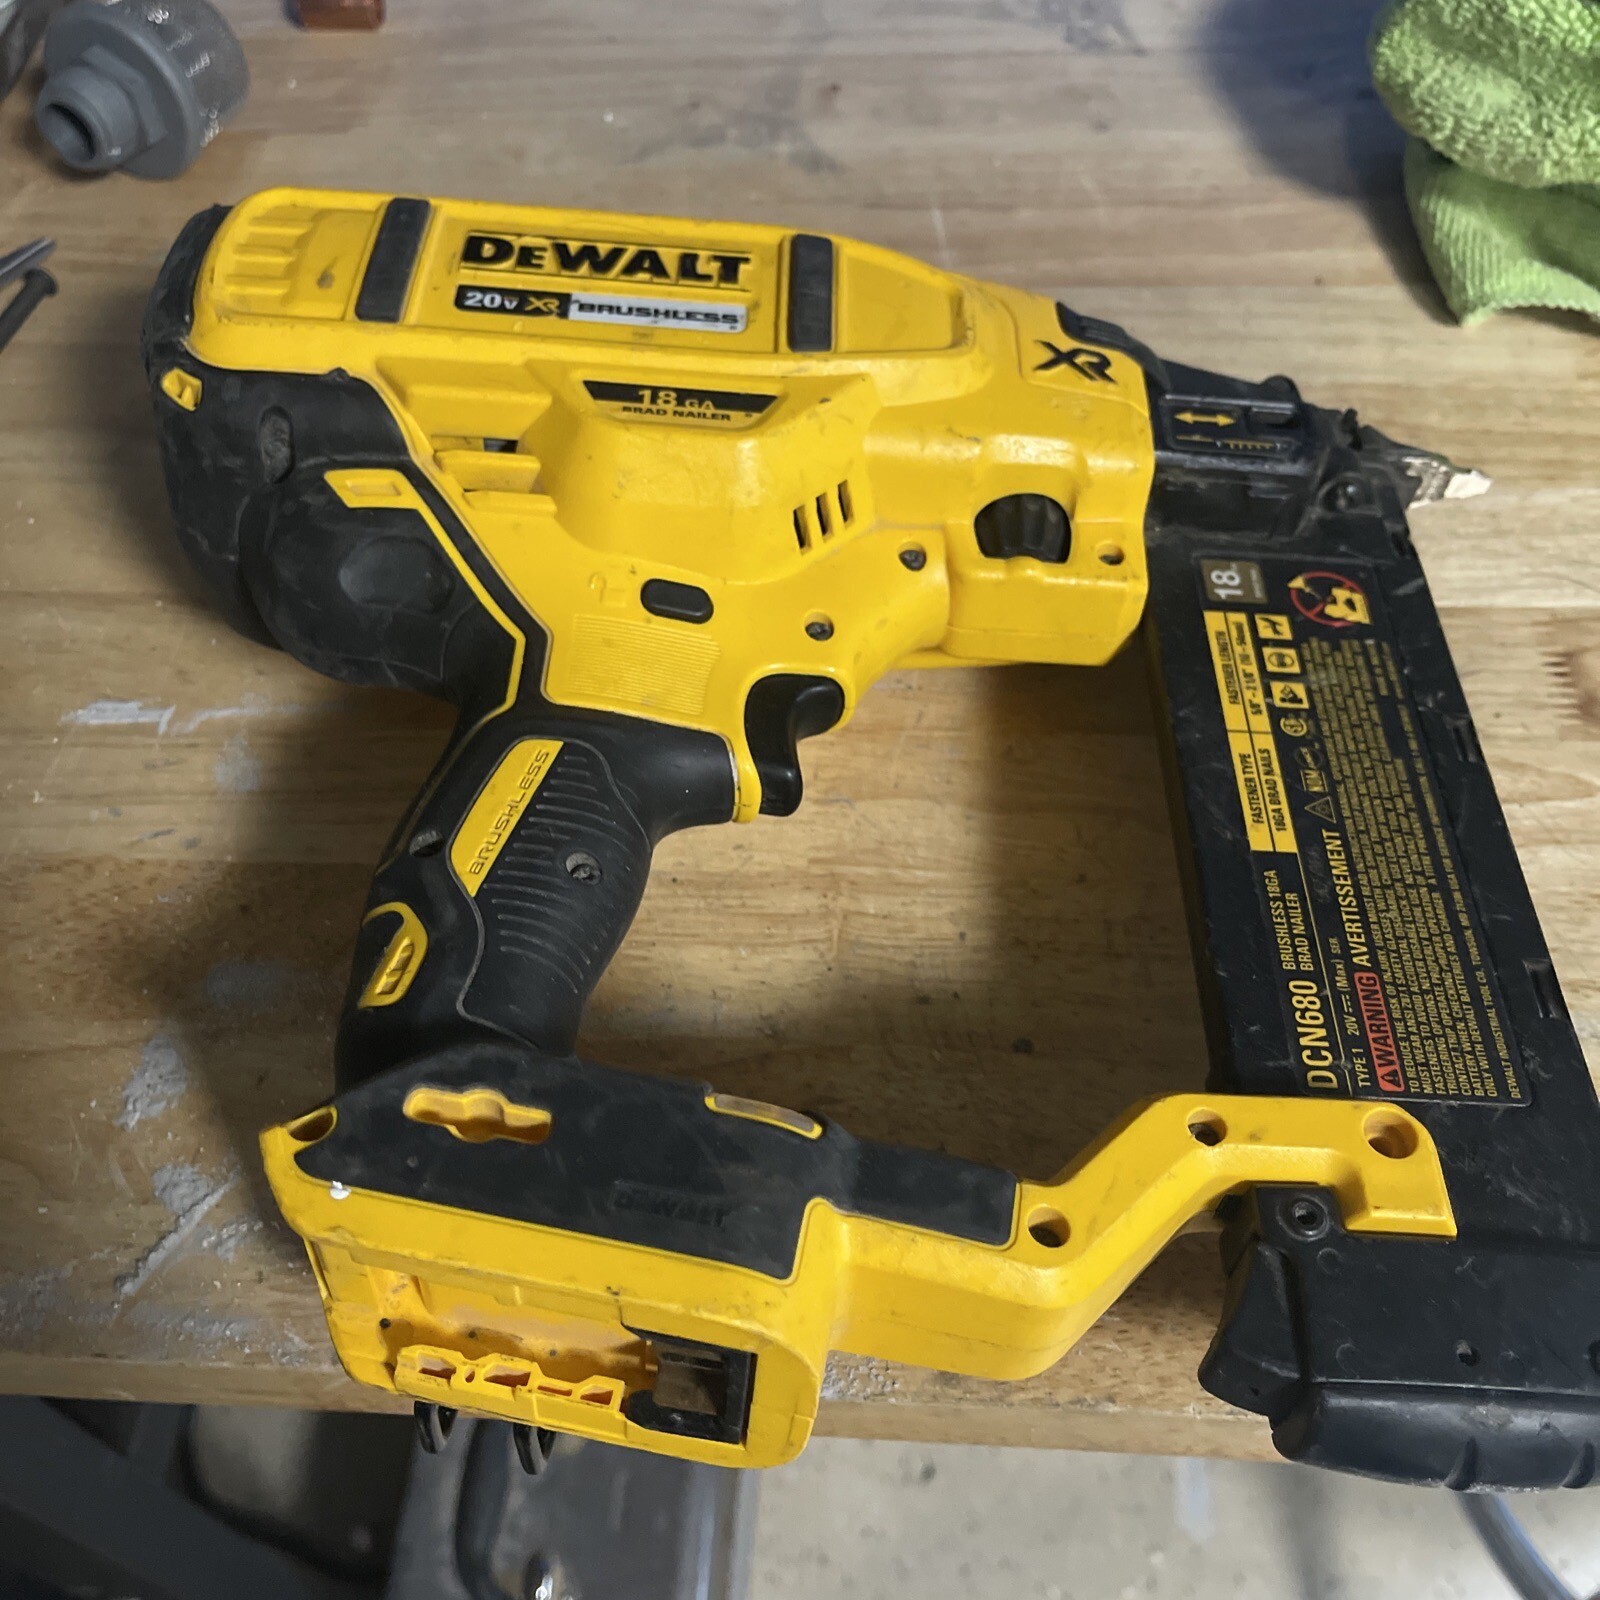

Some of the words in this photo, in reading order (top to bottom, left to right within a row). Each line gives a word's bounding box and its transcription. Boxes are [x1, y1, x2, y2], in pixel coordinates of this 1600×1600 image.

[461, 234, 751, 285] DEWALT
[577, 303, 740, 325] BRUSHLESS
[1033, 339, 1118, 384] XR
[622, 405, 668, 416] BRAD
[672, 409, 731, 421] NAILER
[638, 389, 678, 408] 18
[684, 400, 716, 411] GA
[1210, 569, 1242, 598] 18
[1238, 753, 1253, 775] TYPE
[1258, 748, 1274, 776] NAILS
[1244, 777, 1263, 823] FASTENER
[1264, 778, 1281, 805] BRAD
[469, 750, 550, 875] BRUSHLESS
[1270, 807, 1286, 831] 18GA
[1263, 870, 1280, 897] 18GA
[1322, 830, 1370, 965] AVERTISSEMENT
[1357, 873, 1371, 895] READ
[1372, 887, 1386, 910] WITH
[1285, 892, 1305, 934] NAILER
[1363, 897, 1377, 922] MUST
[1412, 906, 1428, 938] BEFORE
[1419, 886, 1439, 934] OPERATION
[1269, 901, 1295, 969] BRUSHLESS
[1370, 923, 1383, 946] USER
[1378, 912, 1396, 950] GLASSES
[1404, 923, 1422, 958] DISABLE
[1443, 933, 1456, 952] AND
[1294, 937, 1313, 970] BRAD
[1389, 951, 1405, 984] SAFETY
[1398, 938, 1419, 992] ACCIDENTAL
[1421, 939, 1441, 983] PROPERLY
[1331, 959, 1350, 991] (Max)
[1384, 984, 1396, 995] OF
[1414, 960, 1430, 989] NEVER
[1449, 954, 1470, 1001] BATTERIES
[1388, 997, 1402, 1018] RISK
[1411, 994, 1427, 1022] AVOID
[1433, 985, 1452, 1025] OPERATE
[1441, 972, 1462, 1017] CHECKING
[1479, 984, 1493, 1005] TOOL
[1289, 980, 1338, 1088] DCN680
[1343, 1014, 1359, 1035] 20V
[1357, 976, 1395, 1067] WARNING
[1393, 1021, 1406, 1037] THE
[1403, 1009, 1418, 1032] ANSI
[1419, 1024, 1431, 1036] TO
[1462, 1003, 1481, 1041] DEWALT
[1486, 1008, 1508, 1059] INDUSTRIAL
[1410, 1034, 1425, 1062] WEAR
[1444, 1027, 1458, 1048] TRIP
[1398, 1041, 1416, 1077] REDUCE
[1423, 1039, 1446, 1094] FASTENERS
[1435, 1037, 1458, 1094] TRIGGERING
[1474, 1043, 1489, 1069] WITH
[1352, 1057, 1370, 1087] TYPE
[1408, 1079, 1420, 1092] TO
[1417, 1065, 1433, 1093] MUST
[1450, 1051, 1471, 1095] CONTACT
[1464, 1053, 1484, 1096] BATTERY
[1481, 1071, 1497, 1096] ONLY
[1501, 1060, 1521, 1098] DEWALT
